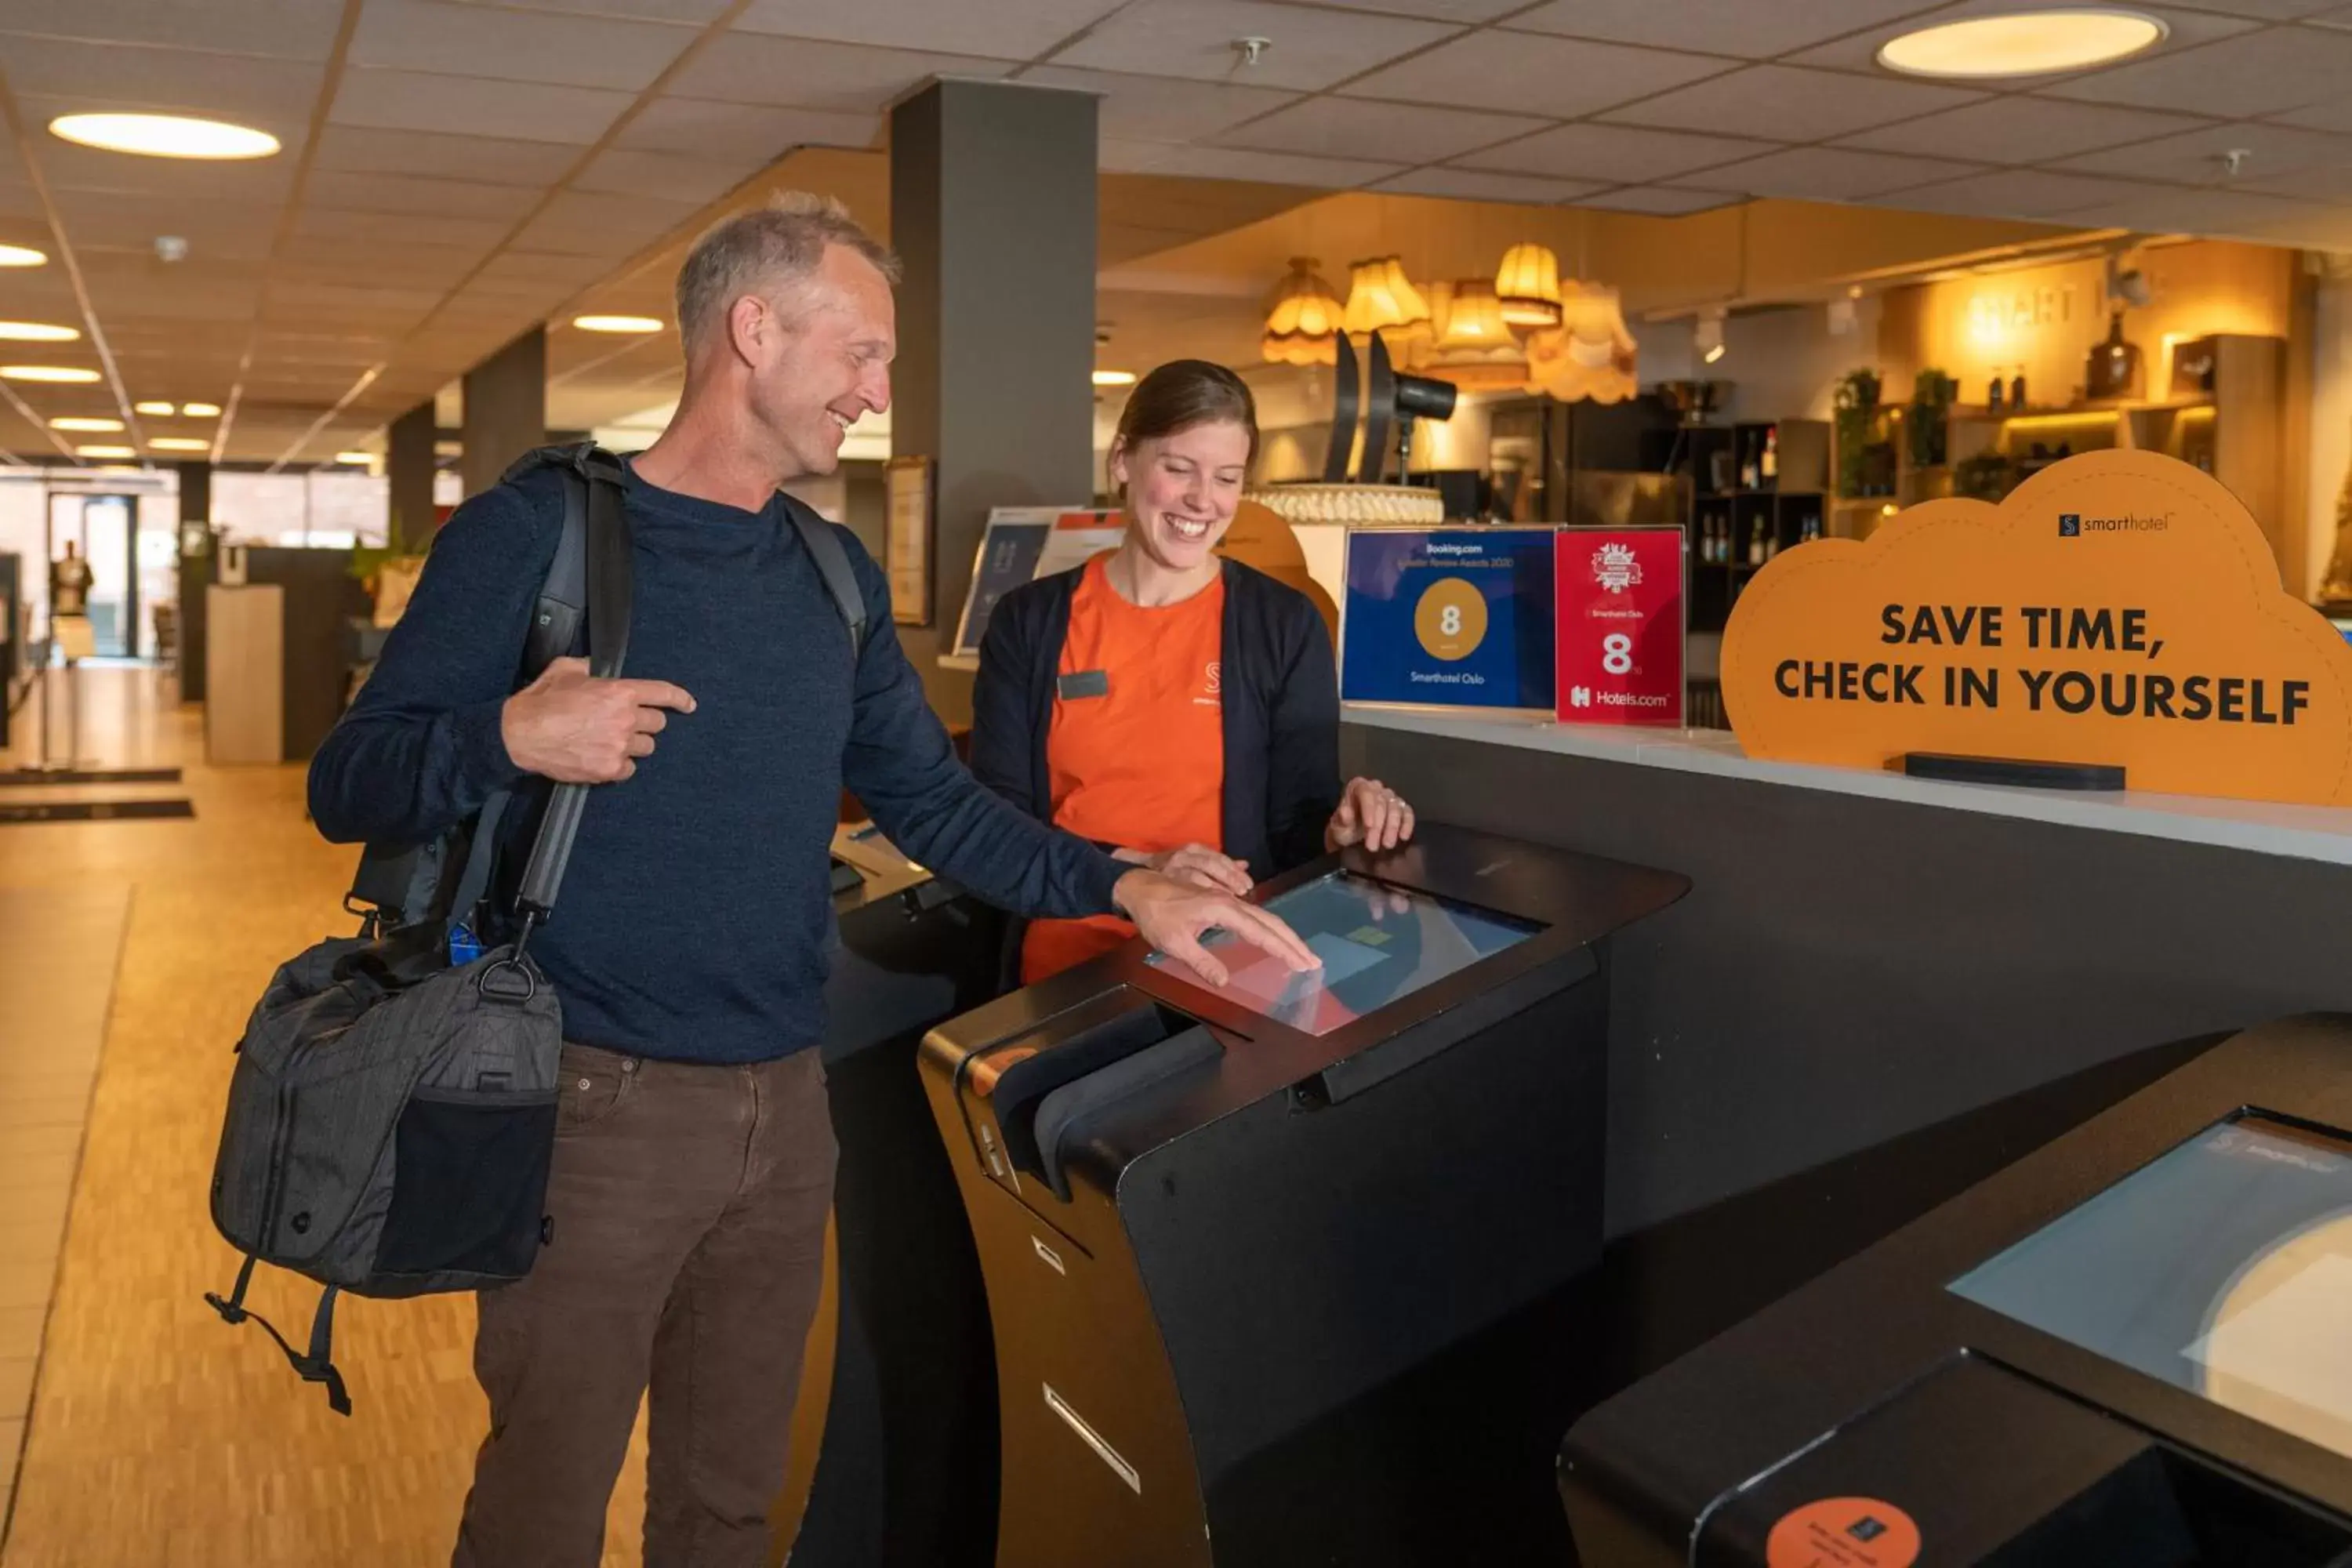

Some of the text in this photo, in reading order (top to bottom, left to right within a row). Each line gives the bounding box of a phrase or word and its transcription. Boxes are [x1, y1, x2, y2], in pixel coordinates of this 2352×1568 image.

[2084, 512, 2169, 532] smarthotel
[1426, 543, 1483, 556] Booking.com
[1440, 604, 1461, 636] 8
[1882, 604, 2165, 659] SAVE TIME,
[1602, 633, 1632, 674] 8
[1410, 671, 1485, 684] Smarthotel Oslo
[1596, 691, 1667, 706] Hotels.com
[1774, 659, 2310, 725] CHECK IN YOURSELF
